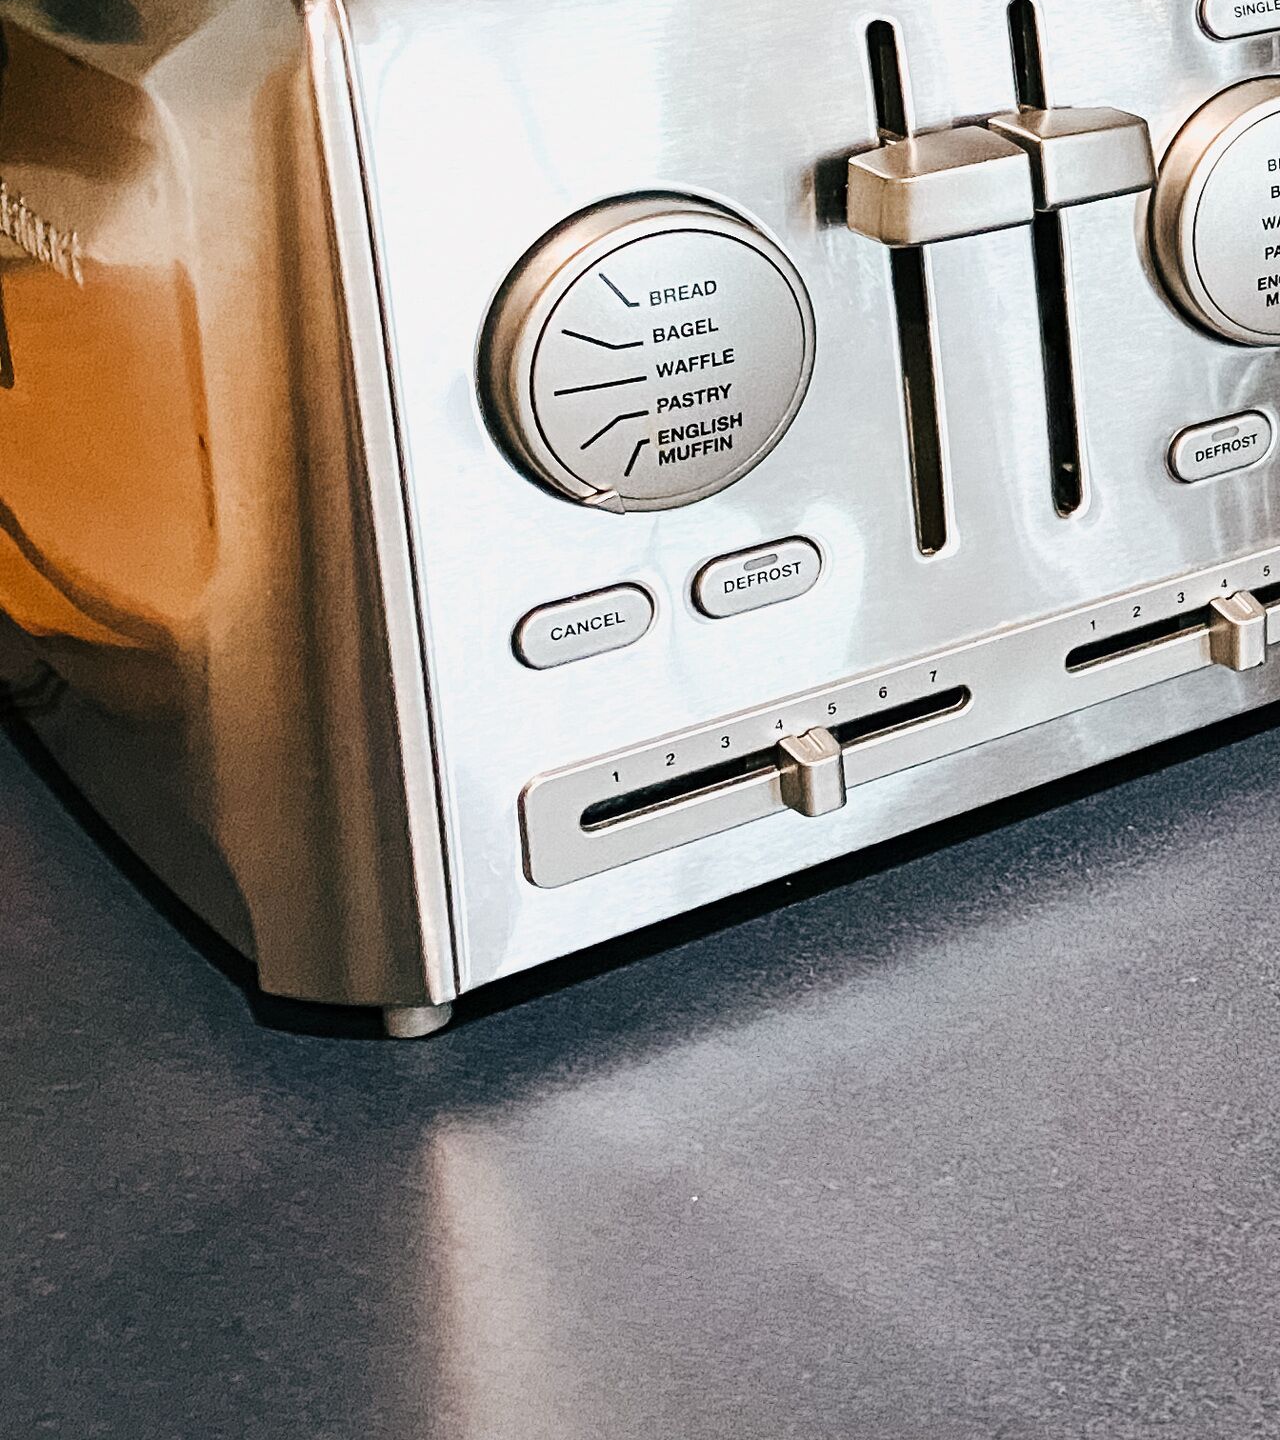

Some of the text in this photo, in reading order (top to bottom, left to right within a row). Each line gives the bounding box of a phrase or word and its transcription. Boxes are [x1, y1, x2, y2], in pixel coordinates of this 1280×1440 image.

[649, 279, 718, 307] BREAD
[652, 316, 720, 344] BAGEL
[655, 348, 736, 378] WAFFLE
[656, 383, 733, 414] PASTRY
[657, 412, 743, 446] ENGLISH
[657, 435, 733, 466] MUFFIN
[1194, 433, 1259, 463] DEFROST
[723, 561, 802, 594] DEFROST
[1090, 620, 1097, 631] 1
[1131, 605, 1142, 618] 2
[1176, 592, 1186, 604] 3
[1220, 578, 1229, 590] 4
[1262, 565, 1272, 577] 5
[550, 612, 626, 642] CANCEL
[612, 670, 938, 784] 1 2 3 4 5 6 7
